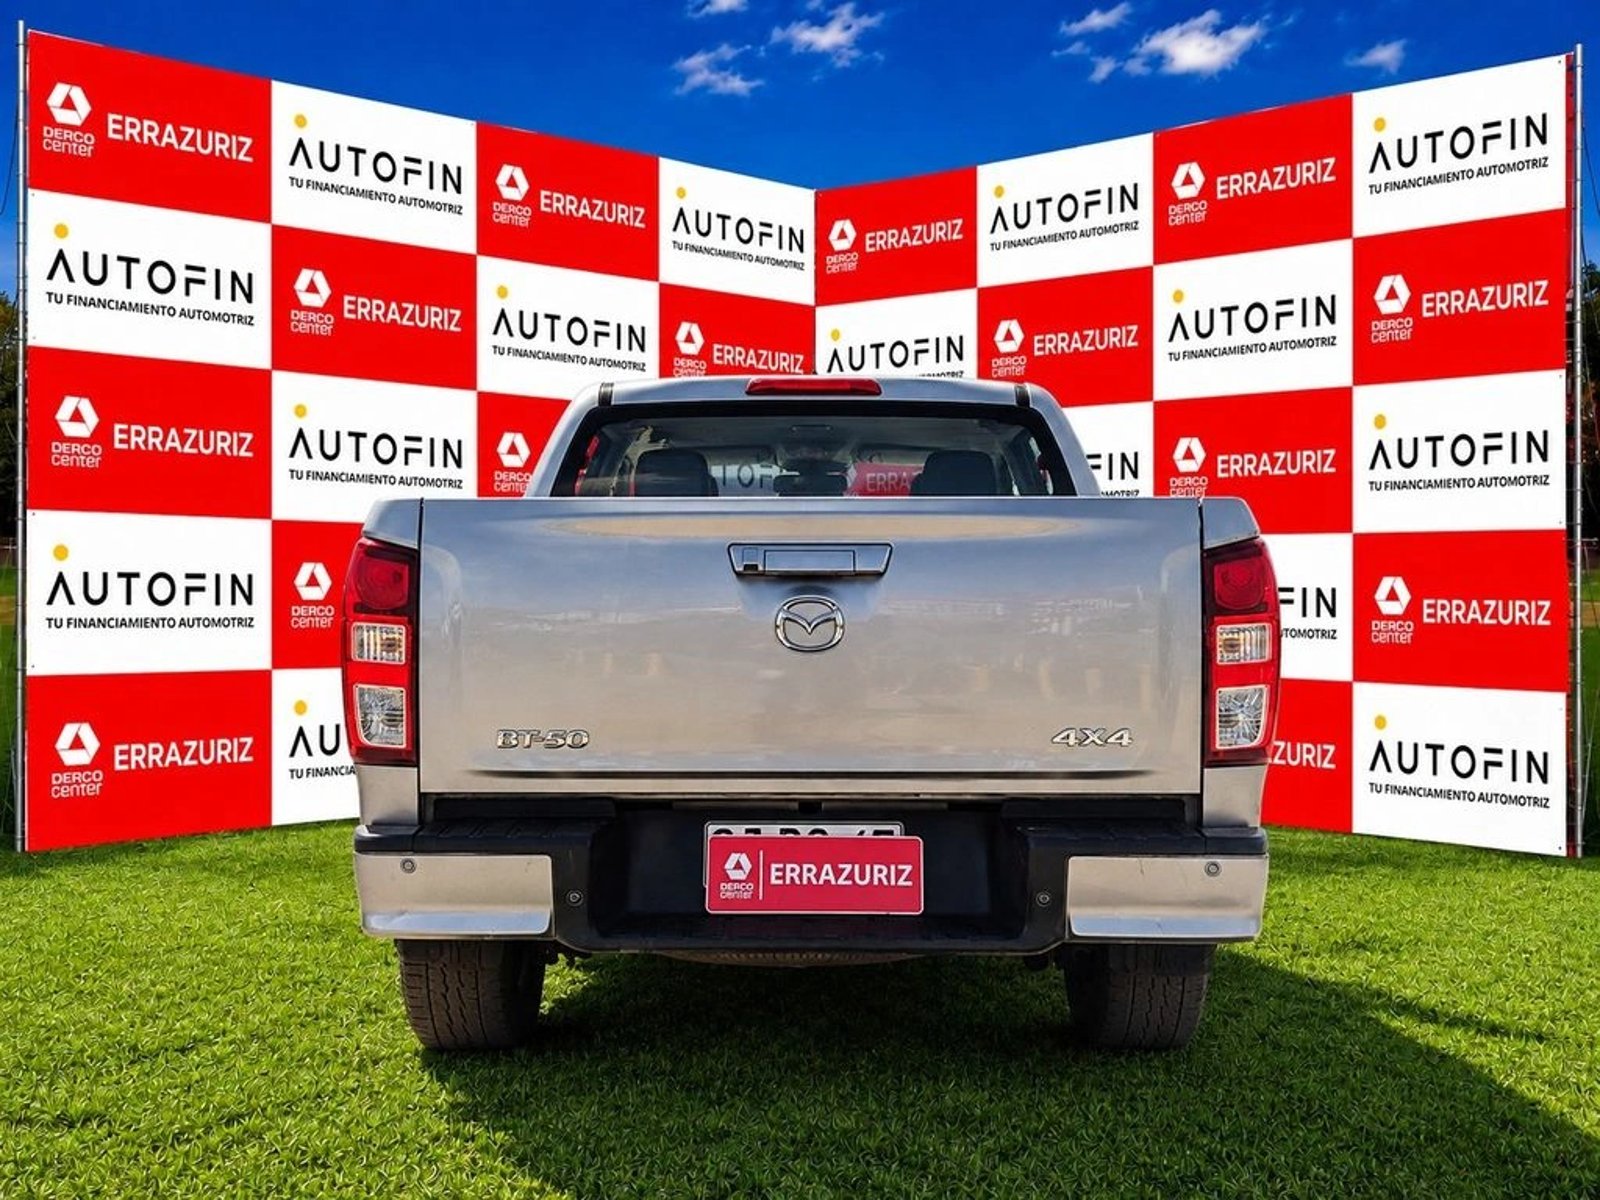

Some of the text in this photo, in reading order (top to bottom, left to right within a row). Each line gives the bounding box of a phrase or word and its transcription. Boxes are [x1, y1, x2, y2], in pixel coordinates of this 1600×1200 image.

[43, 126, 95, 145] DERCO
[107, 113, 253, 163] ERRAZURIZ
[1368, 112, 1547, 174] AUTOFIN
[43, 138, 94, 157] center
[289, 137, 462, 195] AUTOFIN
[1368, 156, 1549, 195] TU FINANCIAMIENTO AUTOMOTRIZ
[1216, 157, 1336, 200] ERRAZURIZ
[288, 176, 463, 216] TU FINANCIAMIENTO AUTOMOTRIZ
[493, 201, 532, 218] DERCO
[493, 212, 530, 226] center
[540, 190, 645, 228] ERRAZURIZ
[990, 182, 1139, 235] AUTOFIN
[1168, 200, 1207, 218] DERCO
[1168, 210, 1206, 226] center
[672, 207, 804, 254] AUTOFIN
[865, 218, 963, 253] ERRAZURIZ
[990, 220, 1139, 251] TU FINANCIAMIENTO AUTOMOTRIZ
[672, 240, 805, 271] TU FINANCIAMIENTO AUTOMOTRIZ
[826, 251, 859, 265] DERCO
[46, 248, 253, 304] AUTOFIN
[826, 261, 857, 273] center
[46, 291, 255, 327] TU FINANCIAMIENTO AUTOMOTRIZ
[1422, 279, 1549, 318] ERRAZURIZ
[290, 309, 334, 325] DERCO
[343, 295, 462, 332] ERRAZURIZ
[1168, 294, 1336, 343] AUTOFIN
[1371, 317, 1413, 331] DERCO
[290, 321, 333, 335] center
[492, 307, 646, 353] AUTOFIN
[1371, 328, 1412, 343] center
[1033, 324, 1139, 356] ERRAZURIZ
[1168, 335, 1337, 362] TU FINANCIAMIENTO AUTOMOTRIZ
[492, 345, 646, 373] TU FINANCIAMIENTO AUTOMOTRIZ
[674, 357, 707, 370] DERCO
[713, 343, 804, 374] ERRAZURIZ
[826, 335, 964, 373] AUTOFIN
[991, 355, 1027, 368] DERCO
[991, 364, 1026, 377] center
[51, 441, 102, 456] DERCO
[113, 423, 254, 457] ERRAZURIZ
[288, 427, 463, 469] AUTOFIN
[1368, 429, 1549, 471] AUTOFIN
[51, 454, 101, 468] center
[1217, 448, 1336, 478] ERRAZURIZ
[289, 468, 463, 490] TU FINANCIAMIENTO AUTOMOTRIZ
[494, 470, 532, 482] DERCO
[1170, 476, 1208, 490] DERCO
[1368, 474, 1550, 492] TU FINANCIAMIENTO AUTOMOTRIZ
[494, 482, 527, 493] cente
[46, 571, 253, 607] AUTOFIN
[291, 605, 334, 617] DERCO
[291, 614, 333, 628] center
[1422, 598, 1551, 626] ERRAZURIZ
[45, 616, 255, 629] TU FINANCIAMIENTO AUTOMOTRIZ
[1281, 627, 1338, 640] TOMOTRIZ
[1371, 620, 1414, 634] DERCO
[1371, 629, 1413, 644] center
[497, 729, 590, 749] BT-50
[1051, 727, 1133, 747] 4X4
[114, 737, 253, 771] ERRAZURIZ
[1270, 740, 1337, 770] ZURIZ
[1368, 739, 1549, 784] AUTOFIN
[52, 770, 103, 785] DERCO
[289, 765, 356, 780] TU FINANCIA
[51, 782, 102, 798] center
[1368, 782, 1550, 809] TU FINANCIAMIENTO AUTOMOTRIZ
[770, 863, 913, 886] ERRAZURIZ
[720, 882, 754, 892] DERCO
[720, 890, 753, 899] center
